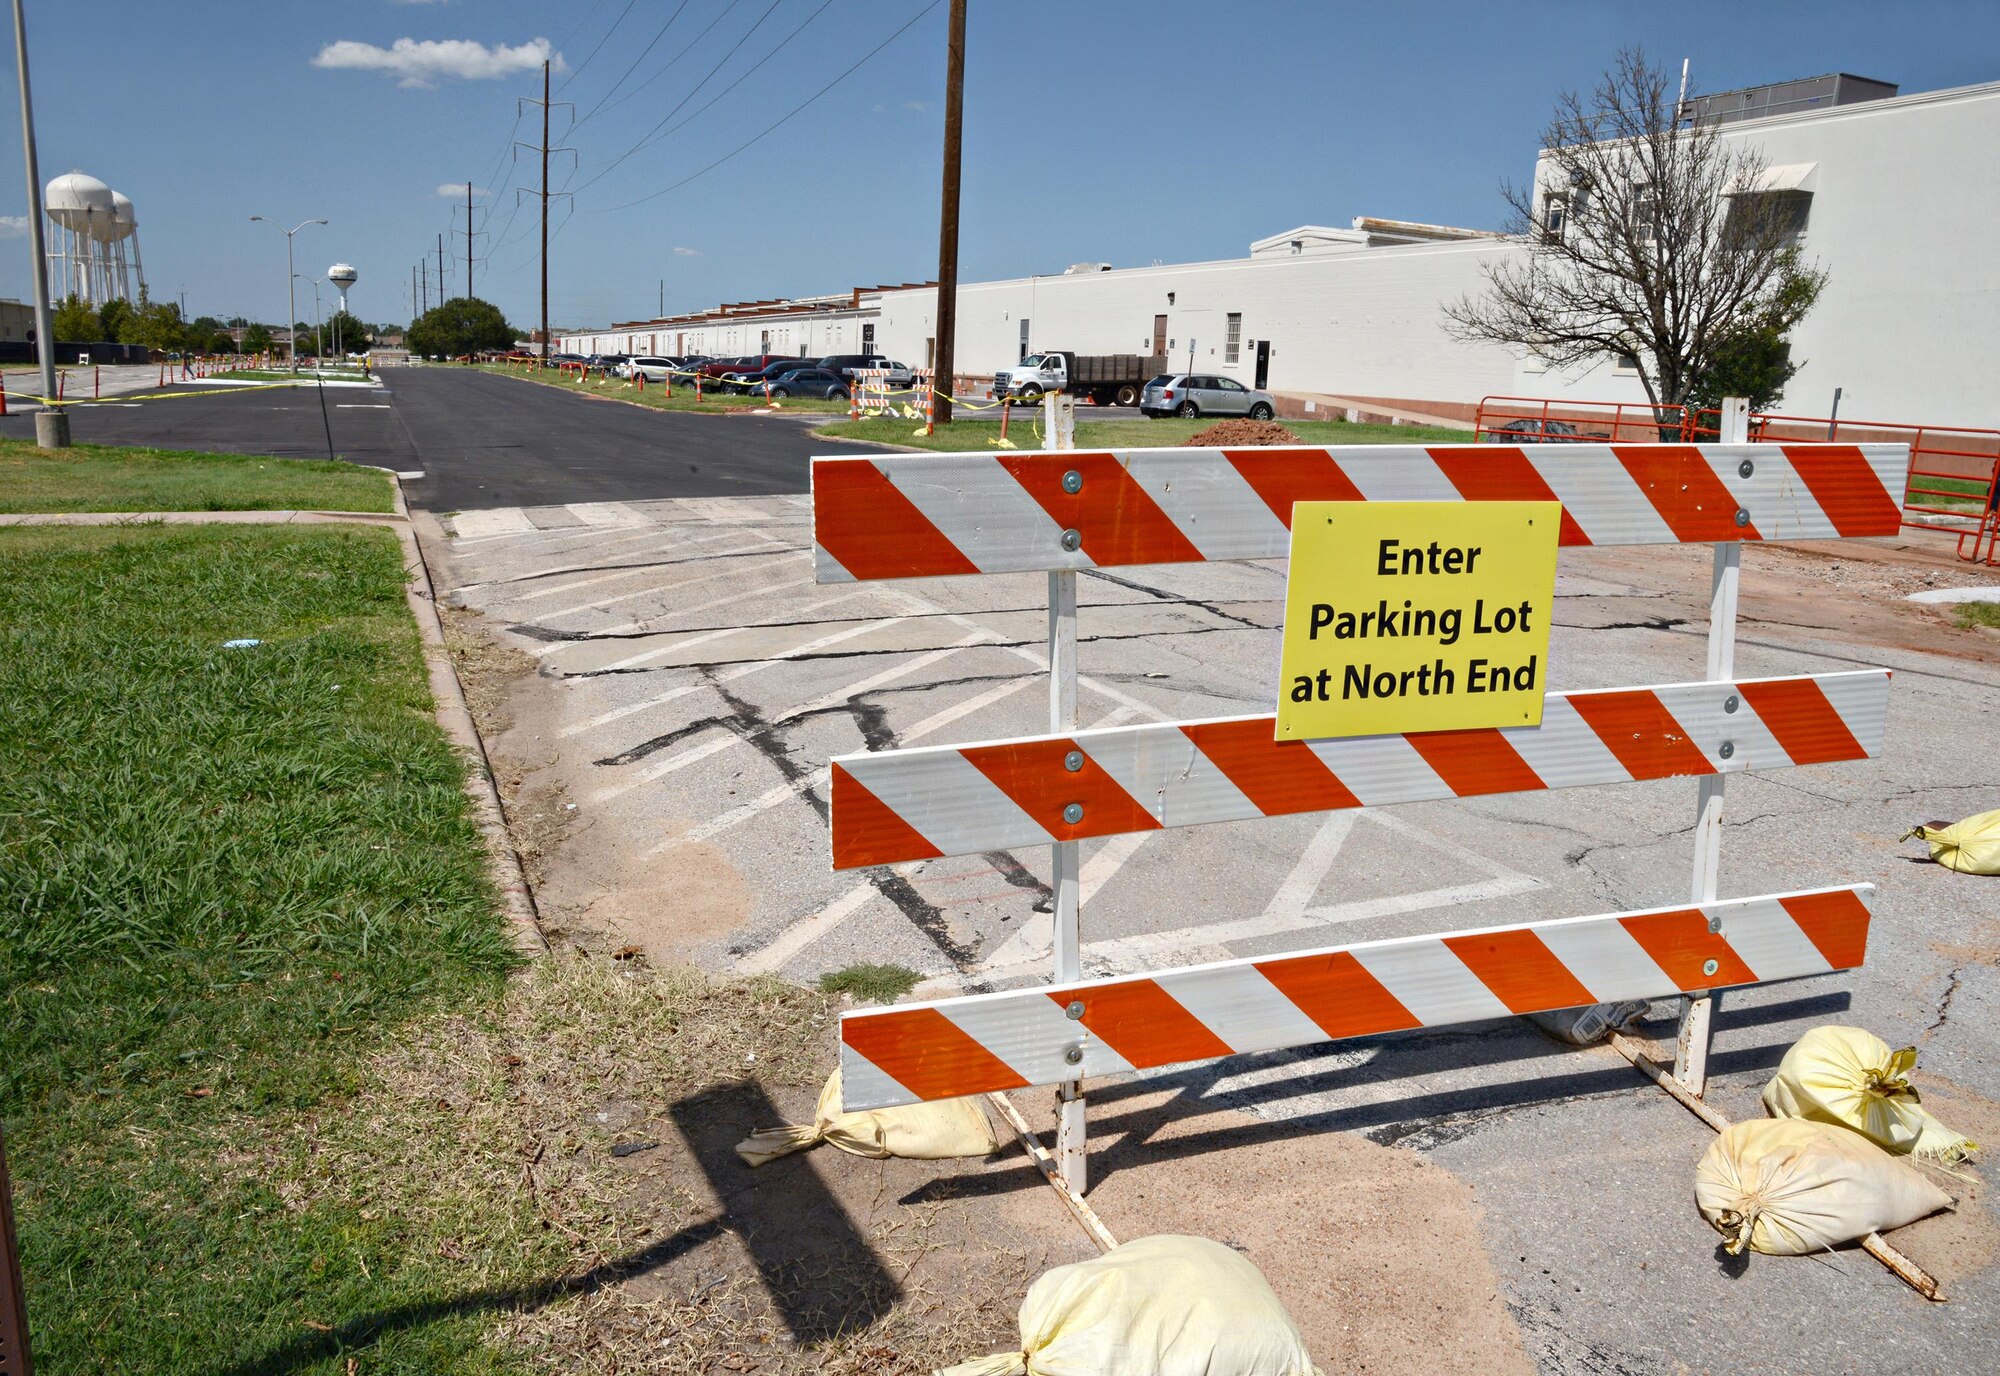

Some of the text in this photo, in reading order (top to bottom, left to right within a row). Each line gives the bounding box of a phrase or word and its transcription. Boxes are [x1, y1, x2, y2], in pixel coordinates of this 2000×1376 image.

[1377, 539, 1482, 576] Enter
[1309, 599, 1532, 645] Parking Lot
[1290, 655, 1537, 703] at North End
